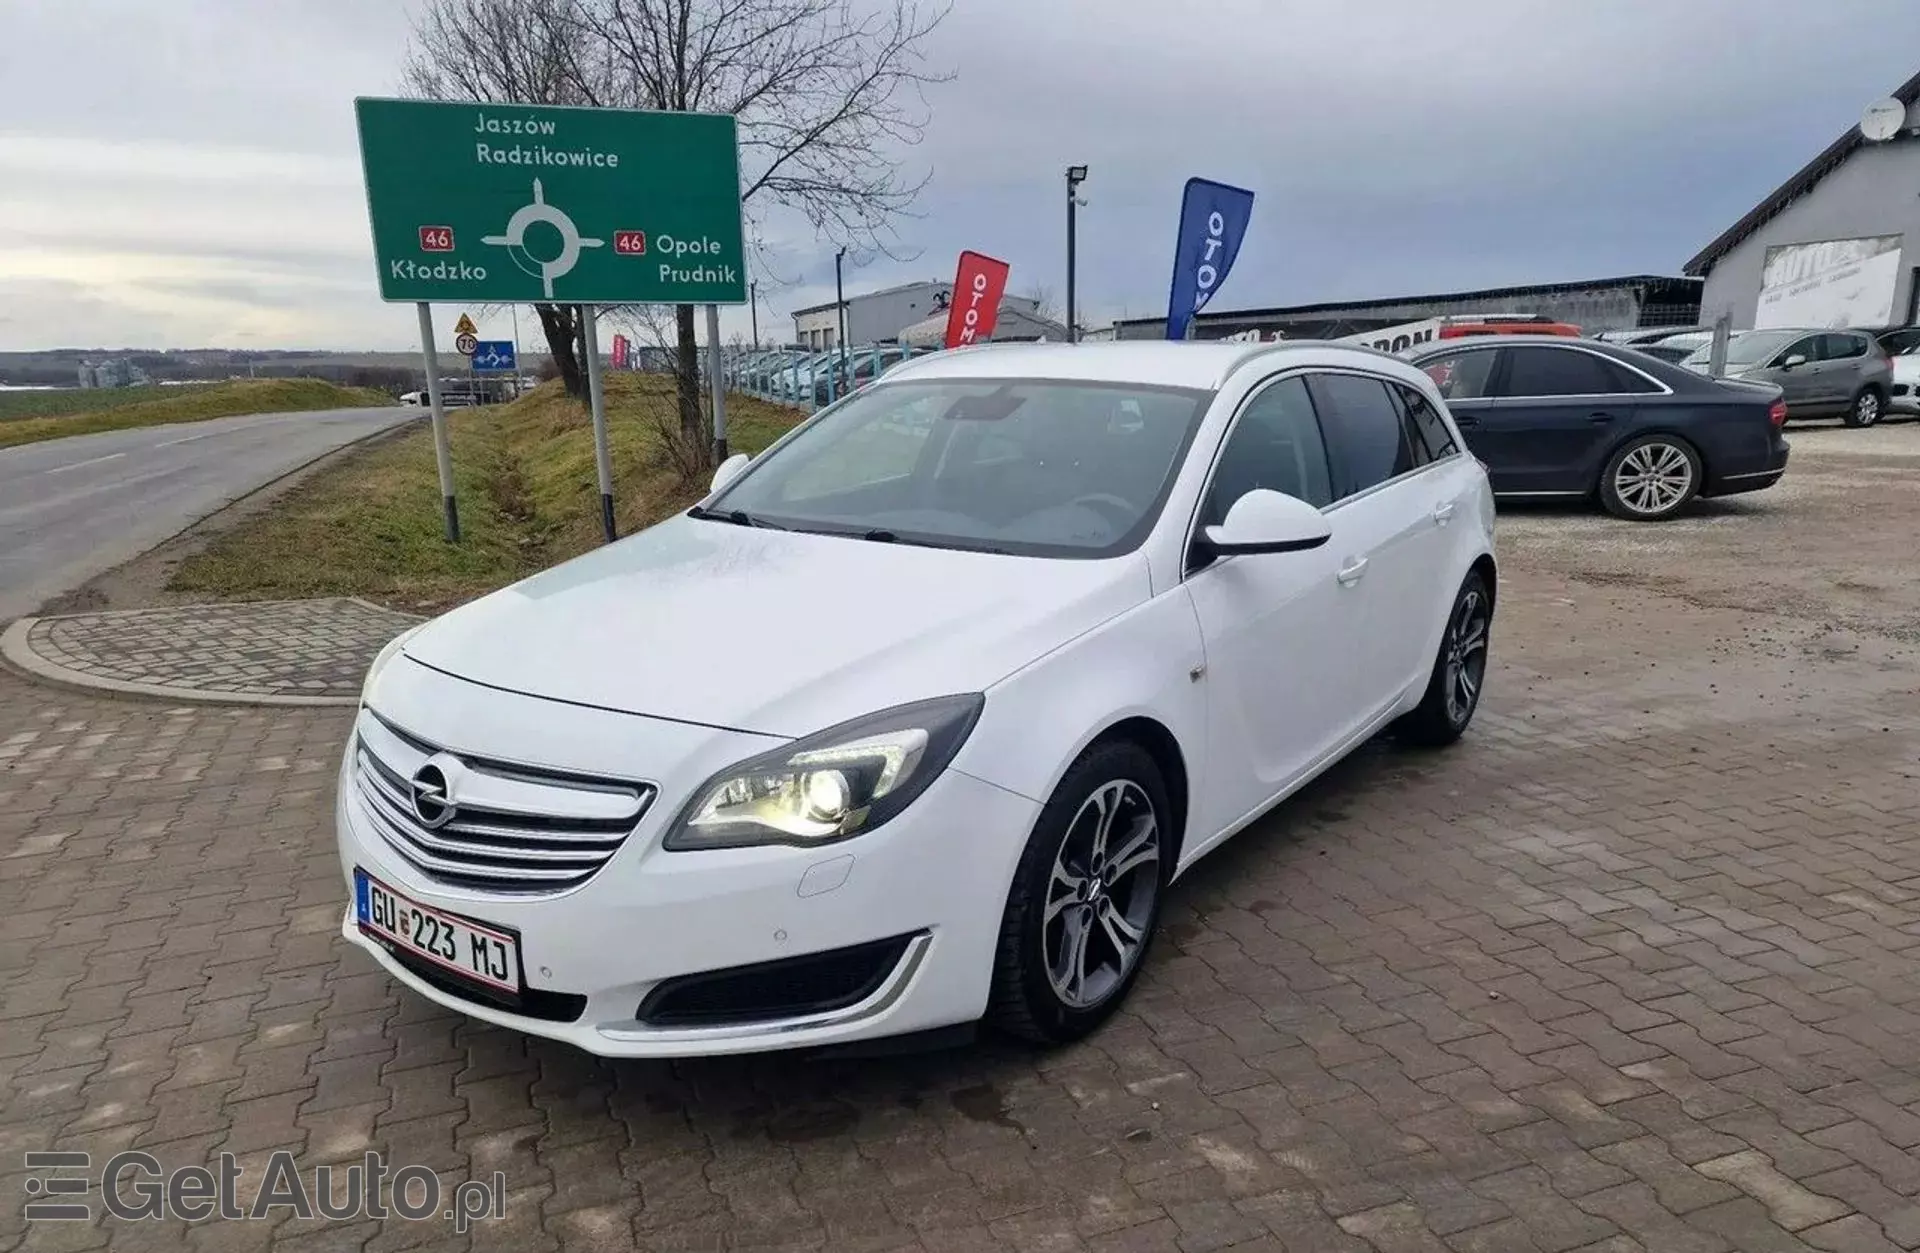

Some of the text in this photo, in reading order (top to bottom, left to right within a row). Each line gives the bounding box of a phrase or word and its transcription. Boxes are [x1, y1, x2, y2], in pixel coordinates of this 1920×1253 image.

[475, 113, 556, 135] Jaszów
[476, 143, 618, 168] Radzikowice
[424, 231, 449, 248] 46
[619, 235, 642, 252] 46
[656, 235, 721, 259] Opole
[391, 260, 487, 281] Kłodzko
[659, 264, 736, 283] Prudnik
[460, 338, 476, 350] 70
[371, 886, 397, 934] GU
[411, 908, 457, 961] 223
[470, 932, 509, 981] MJ
